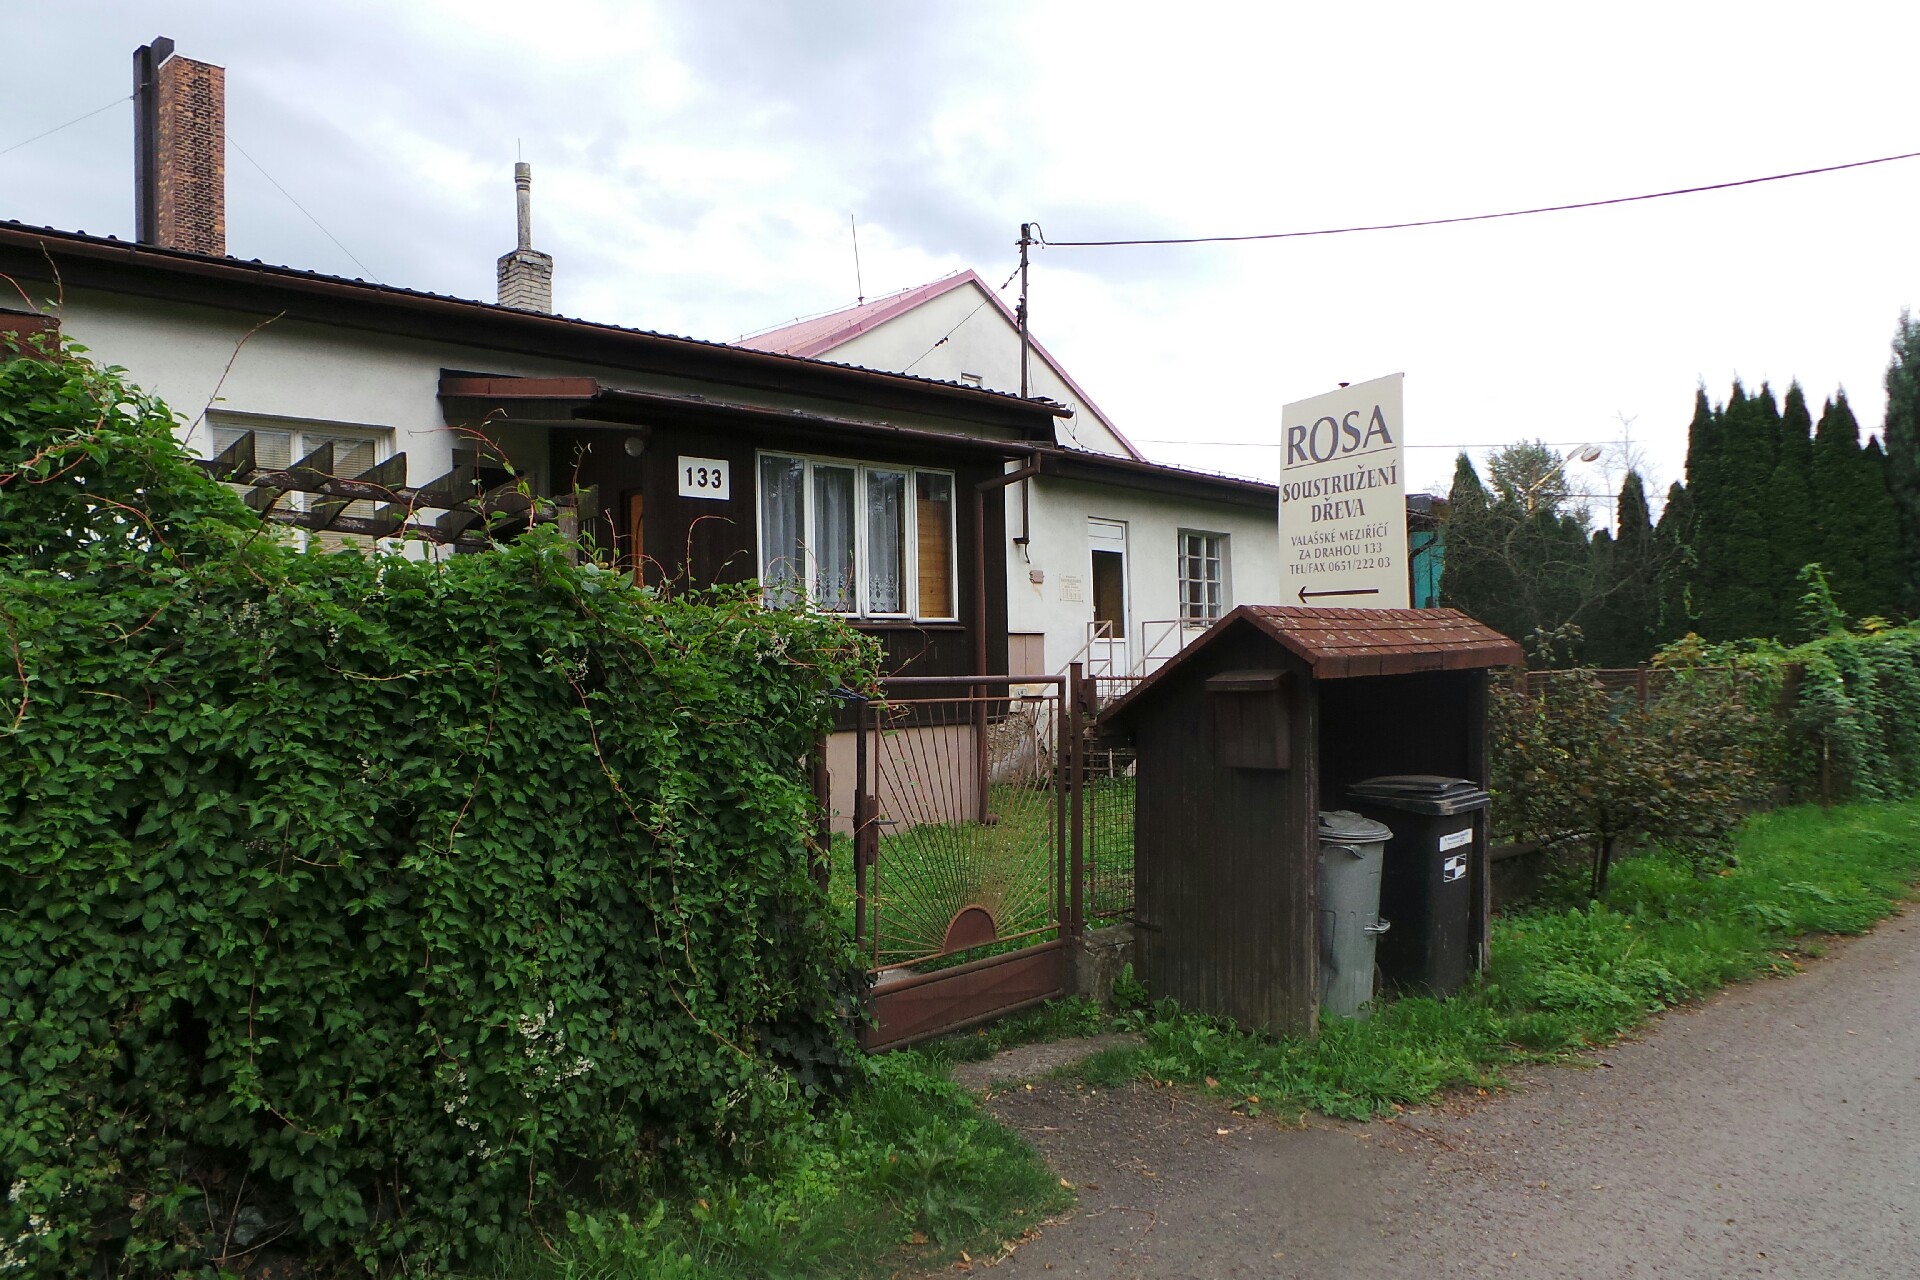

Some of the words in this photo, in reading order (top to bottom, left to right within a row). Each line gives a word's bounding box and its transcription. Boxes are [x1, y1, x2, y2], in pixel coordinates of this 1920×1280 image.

[1287, 405, 1393, 464] ROSA
[686, 466, 722, 489] 133
[1282, 459, 1398, 503] SOUSTRUŽENÍ
[1311, 497, 1366, 523] DŘEVA
[1291, 529, 1336, 546] VALAŠSKÉ
[1340, 522, 1389, 541] MEZIŘÍČÍ
[1299, 549, 1311, 560] ZA
[1314, 544, 1361, 559] DRAHOU
[1364, 542, 1382, 554] 133
[1289, 562, 1326, 575] TEL/FAX
[1328, 558, 1375, 572] 0651/222
[1377, 556, 1391, 568] 03
